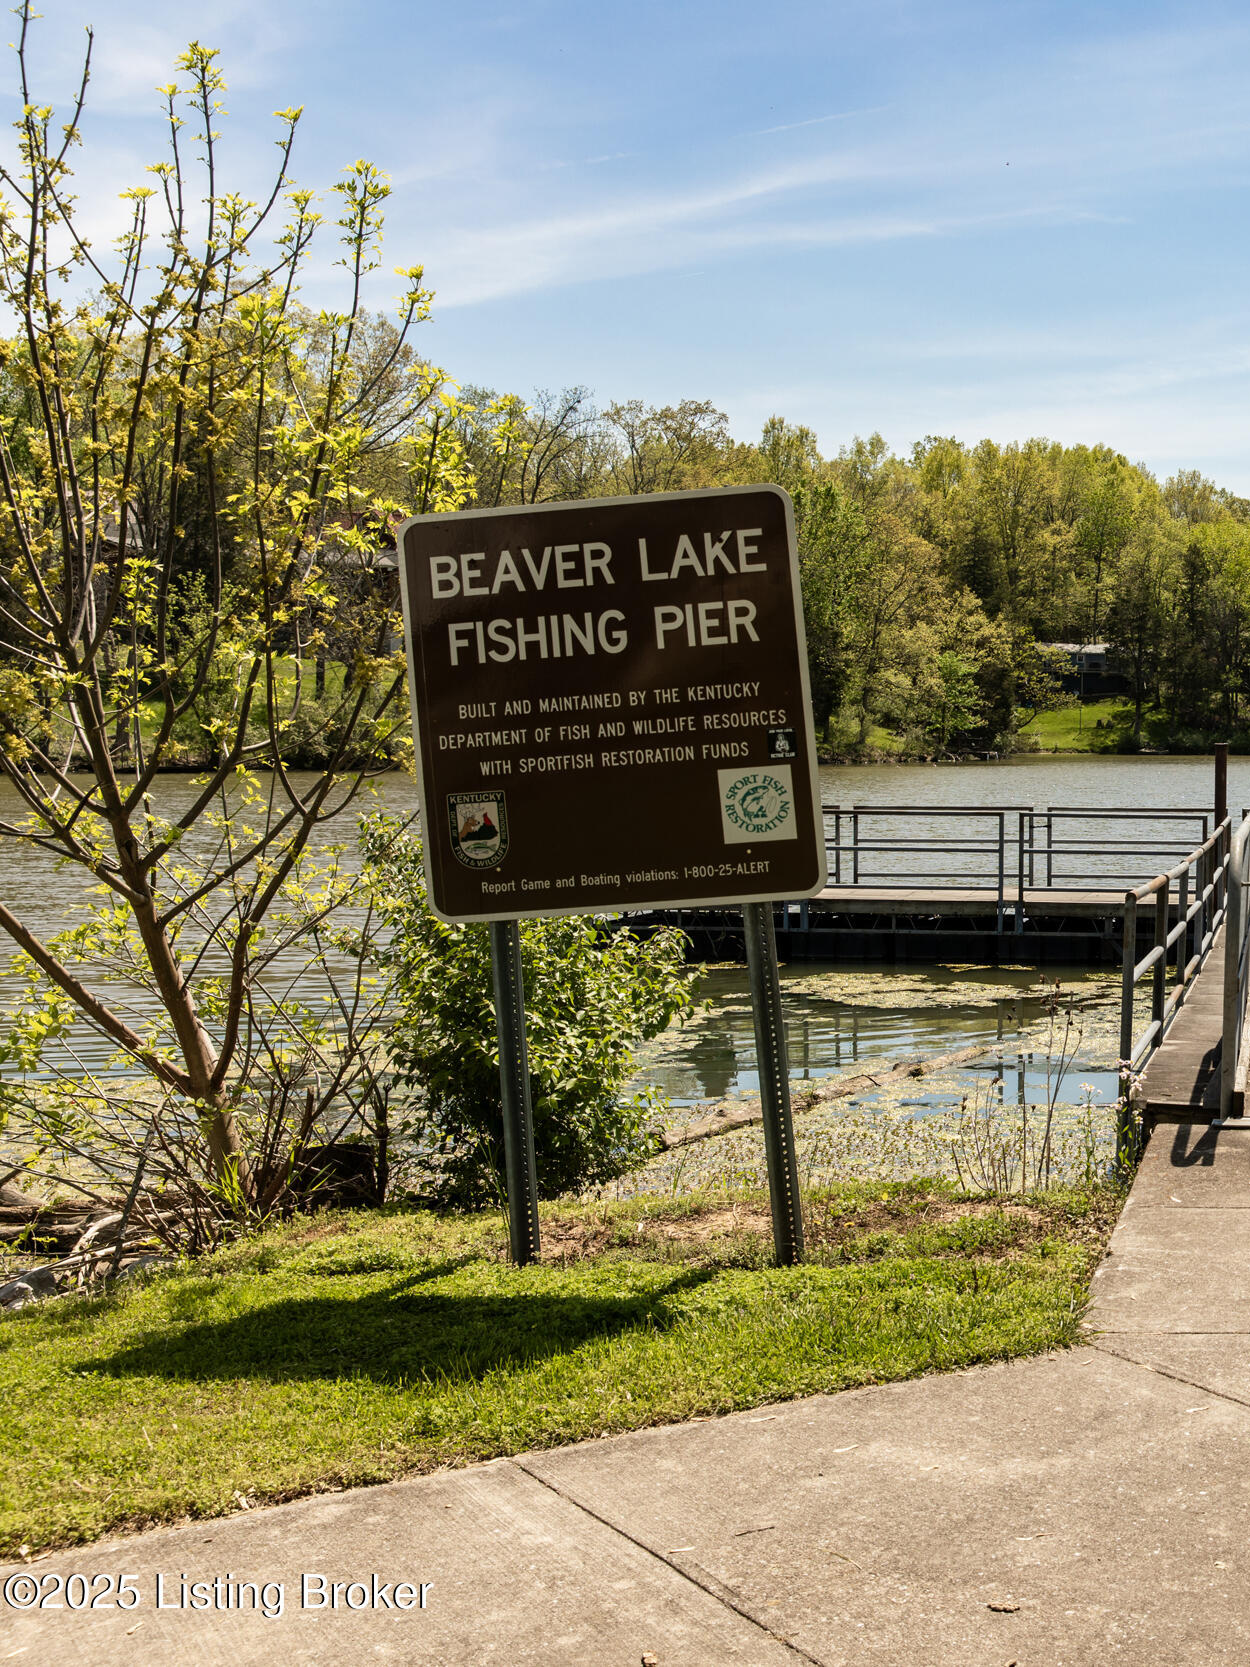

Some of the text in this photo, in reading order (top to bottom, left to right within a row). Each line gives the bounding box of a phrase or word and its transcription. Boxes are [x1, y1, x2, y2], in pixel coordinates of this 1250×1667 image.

[429, 528, 767, 599] BEAVER LAKE
[447, 599, 760, 666] FISHING PIER
[458, 682, 760, 719] BUILT AND MAINTAINED BY THE KENTUCKY
[439, 709, 787, 750] DEPARTMENT OF FISH AND WILDLIFE RESOURCES
[480, 741, 750, 776] WITH SPORTFISH RESTORATION FUNDS
[449, 792, 502, 804] KENTUCKY
[725, 774, 788, 800] SPORT FISH
[725, 800, 791, 833] RESTORATION
[455, 846, 470, 864] FISH
[477, 842, 507, 867] WILDLIFE
[481, 861, 770, 894] Report Game and Boating violations: 1-800-25-ALERT
